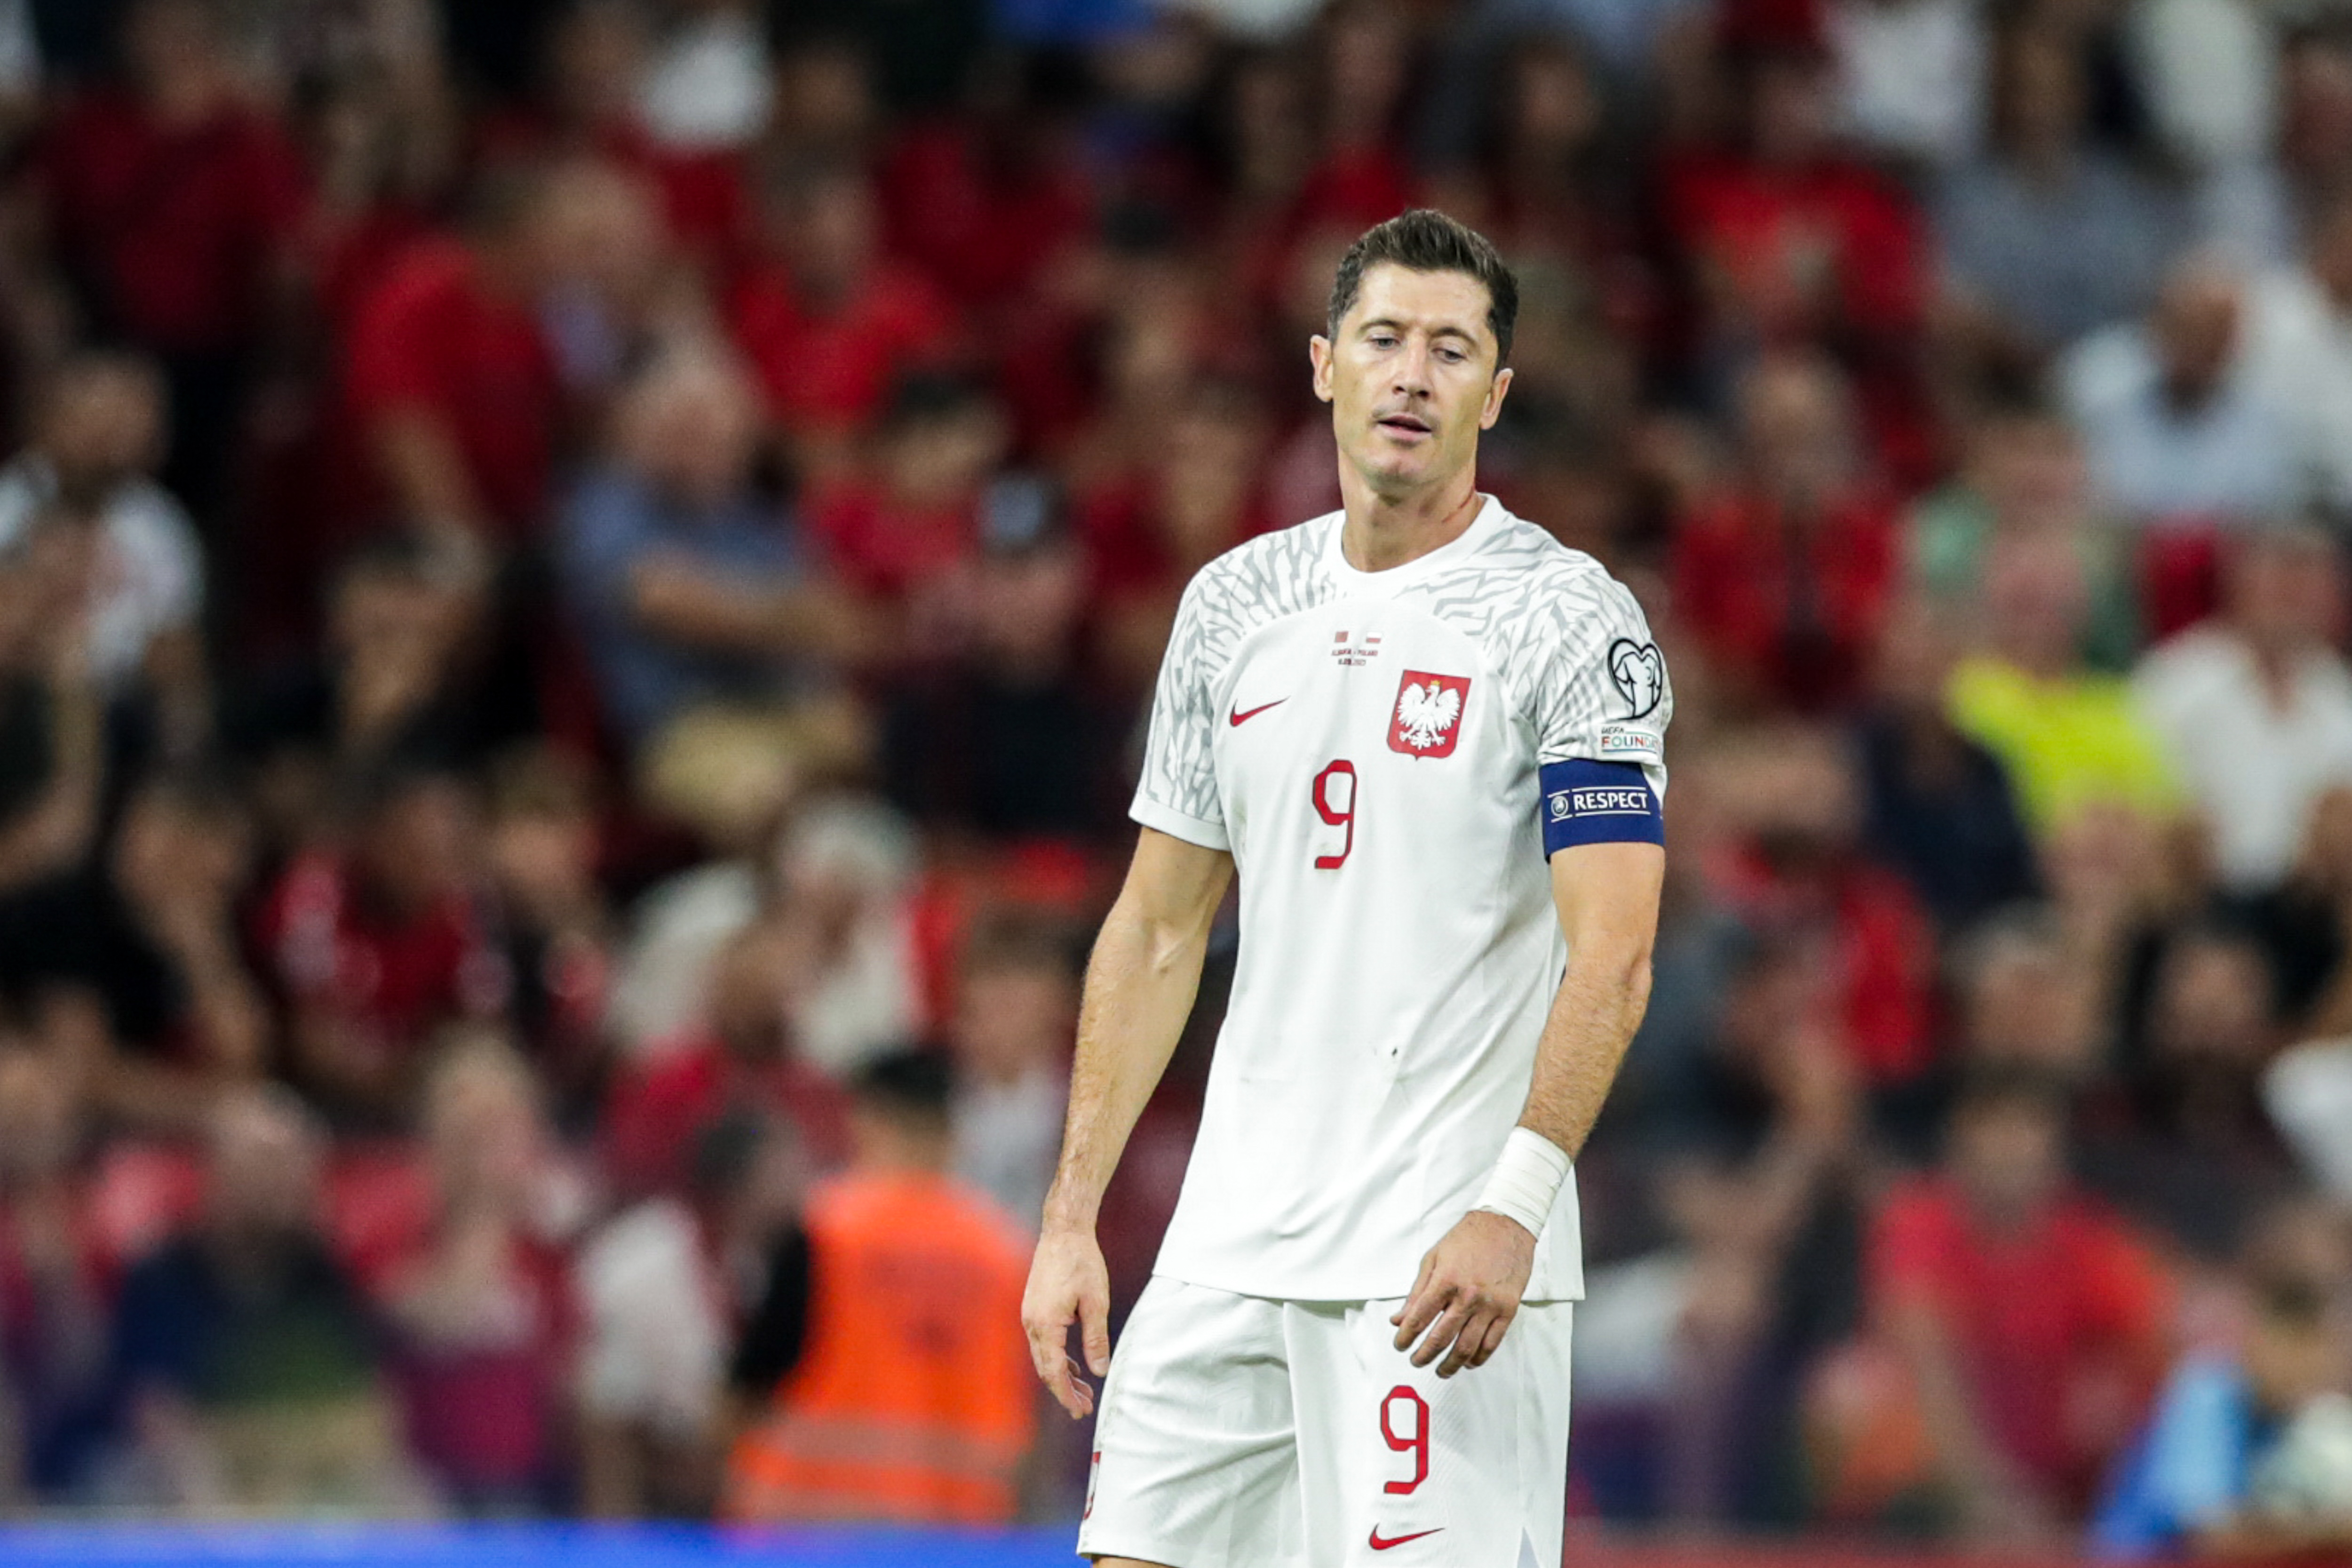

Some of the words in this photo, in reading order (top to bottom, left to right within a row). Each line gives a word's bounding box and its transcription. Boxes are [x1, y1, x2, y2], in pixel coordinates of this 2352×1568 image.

[1312, 758, 1357, 869] 9
[1573, 792, 1647, 810] RESPECT
[1380, 1385, 1430, 1495] 9
